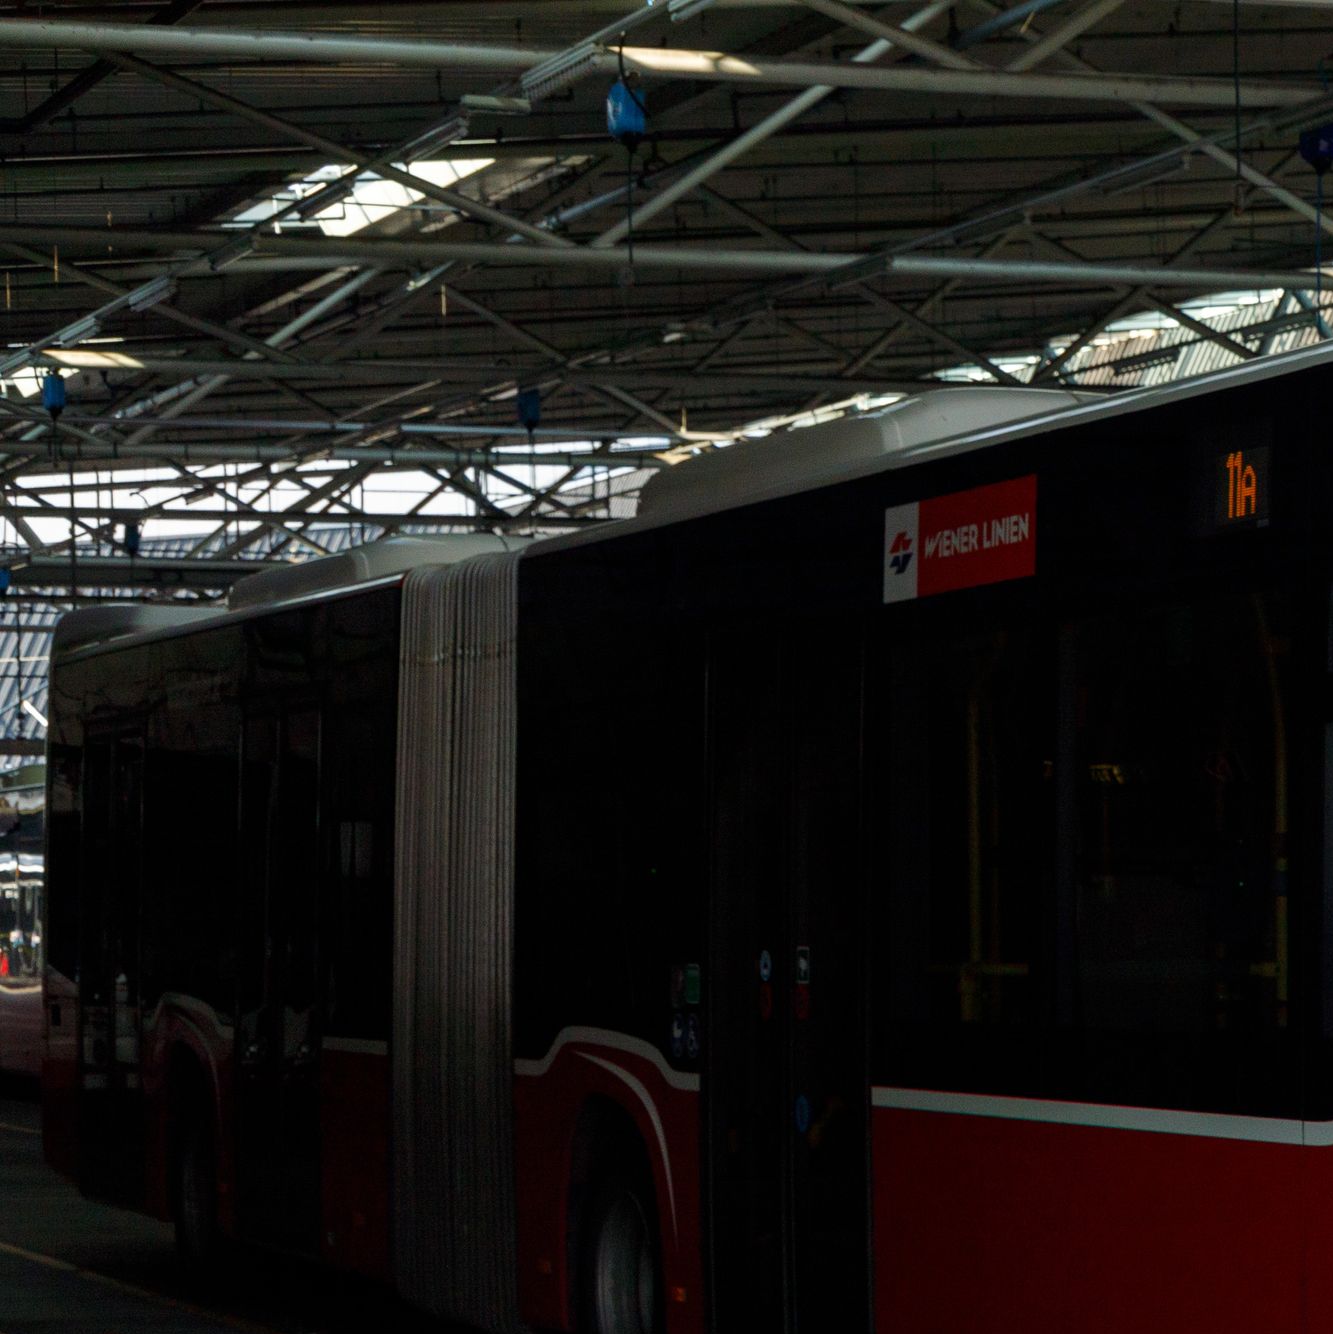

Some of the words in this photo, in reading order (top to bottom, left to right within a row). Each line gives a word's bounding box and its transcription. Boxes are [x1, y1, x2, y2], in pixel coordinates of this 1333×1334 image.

[1226, 450, 1257, 519] 11A
[924, 523, 979, 560] WIENER
[982, 511, 1030, 549] LINIEN
